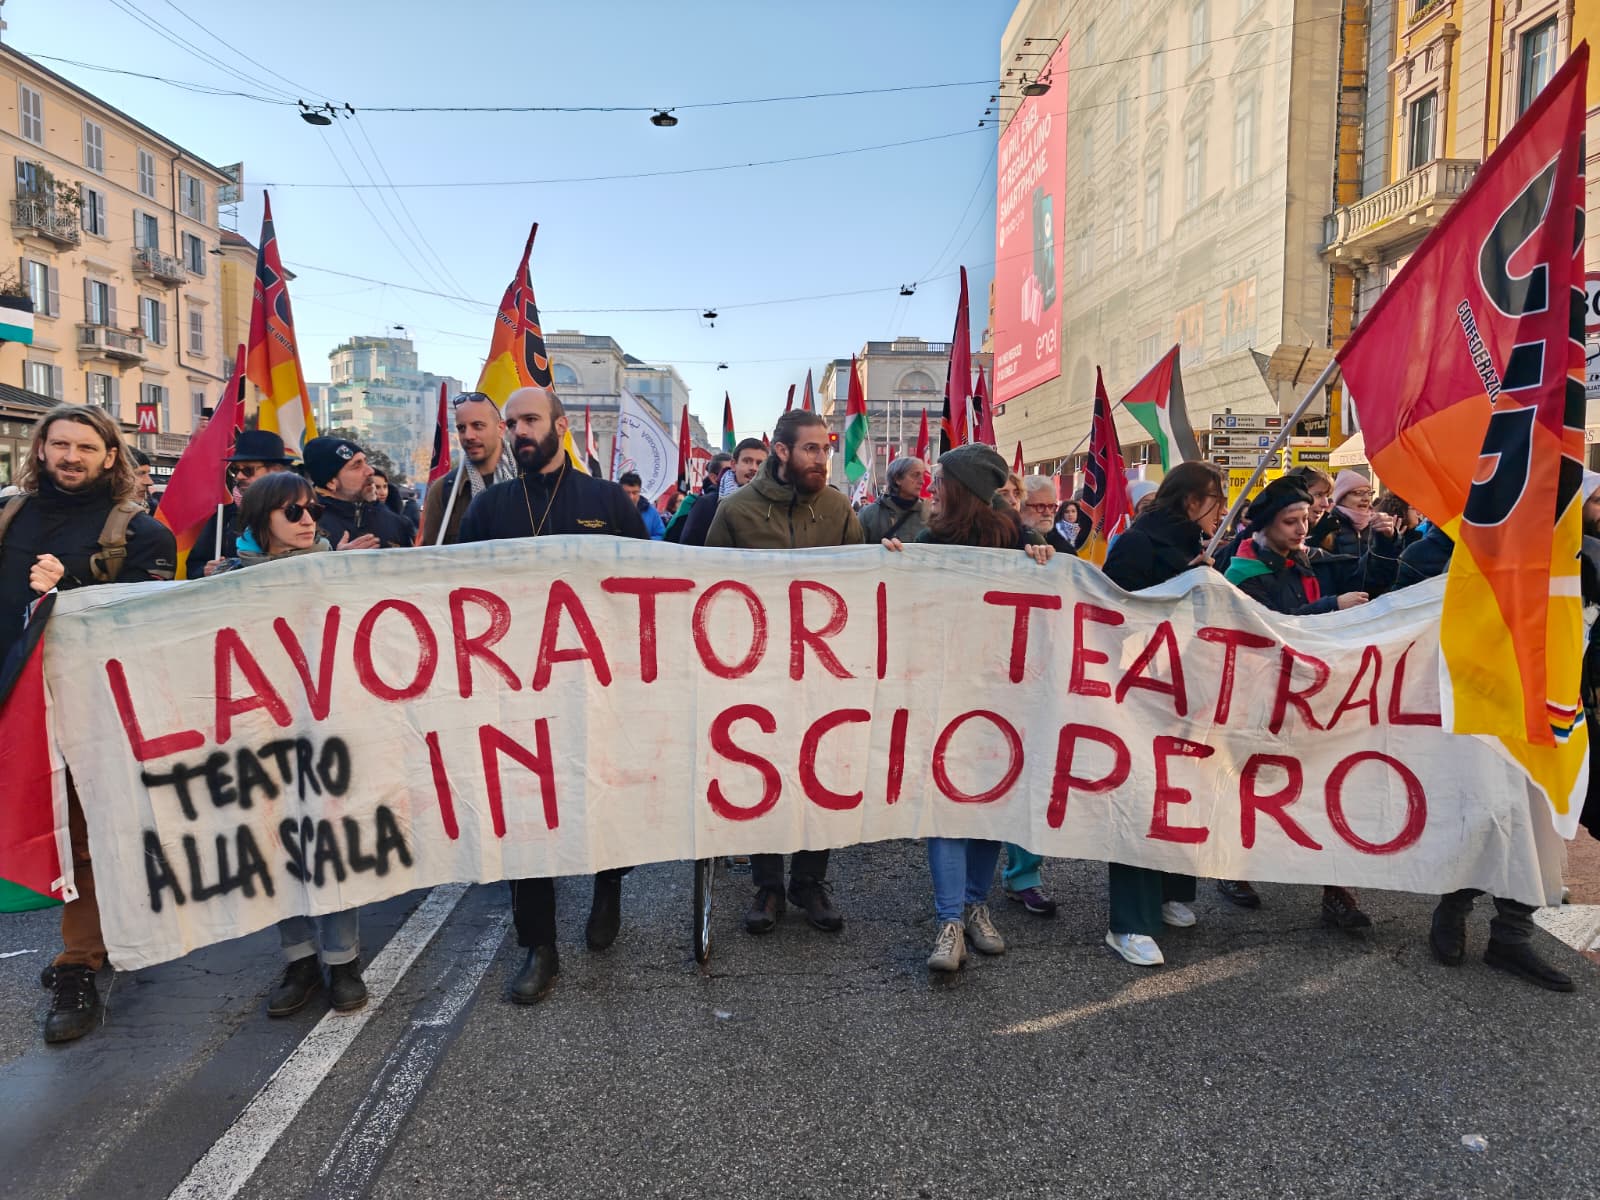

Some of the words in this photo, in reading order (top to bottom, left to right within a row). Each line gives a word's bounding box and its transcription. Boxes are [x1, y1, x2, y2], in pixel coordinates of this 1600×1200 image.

[1033, 112, 1052, 153] UNO
[1035, 319, 1057, 361] enel
[139, 411, 157, 430] M
[1230, 477, 1246, 487] TOP
[105, 576, 886, 761] LAVORATORI
[141, 736, 351, 820] TEATRO
[425, 717, 559, 839] IN
[706, 703, 1428, 856] SCIOPERO
[142, 822, 274, 912] ALLA
[279, 805, 414, 888] SCALA
